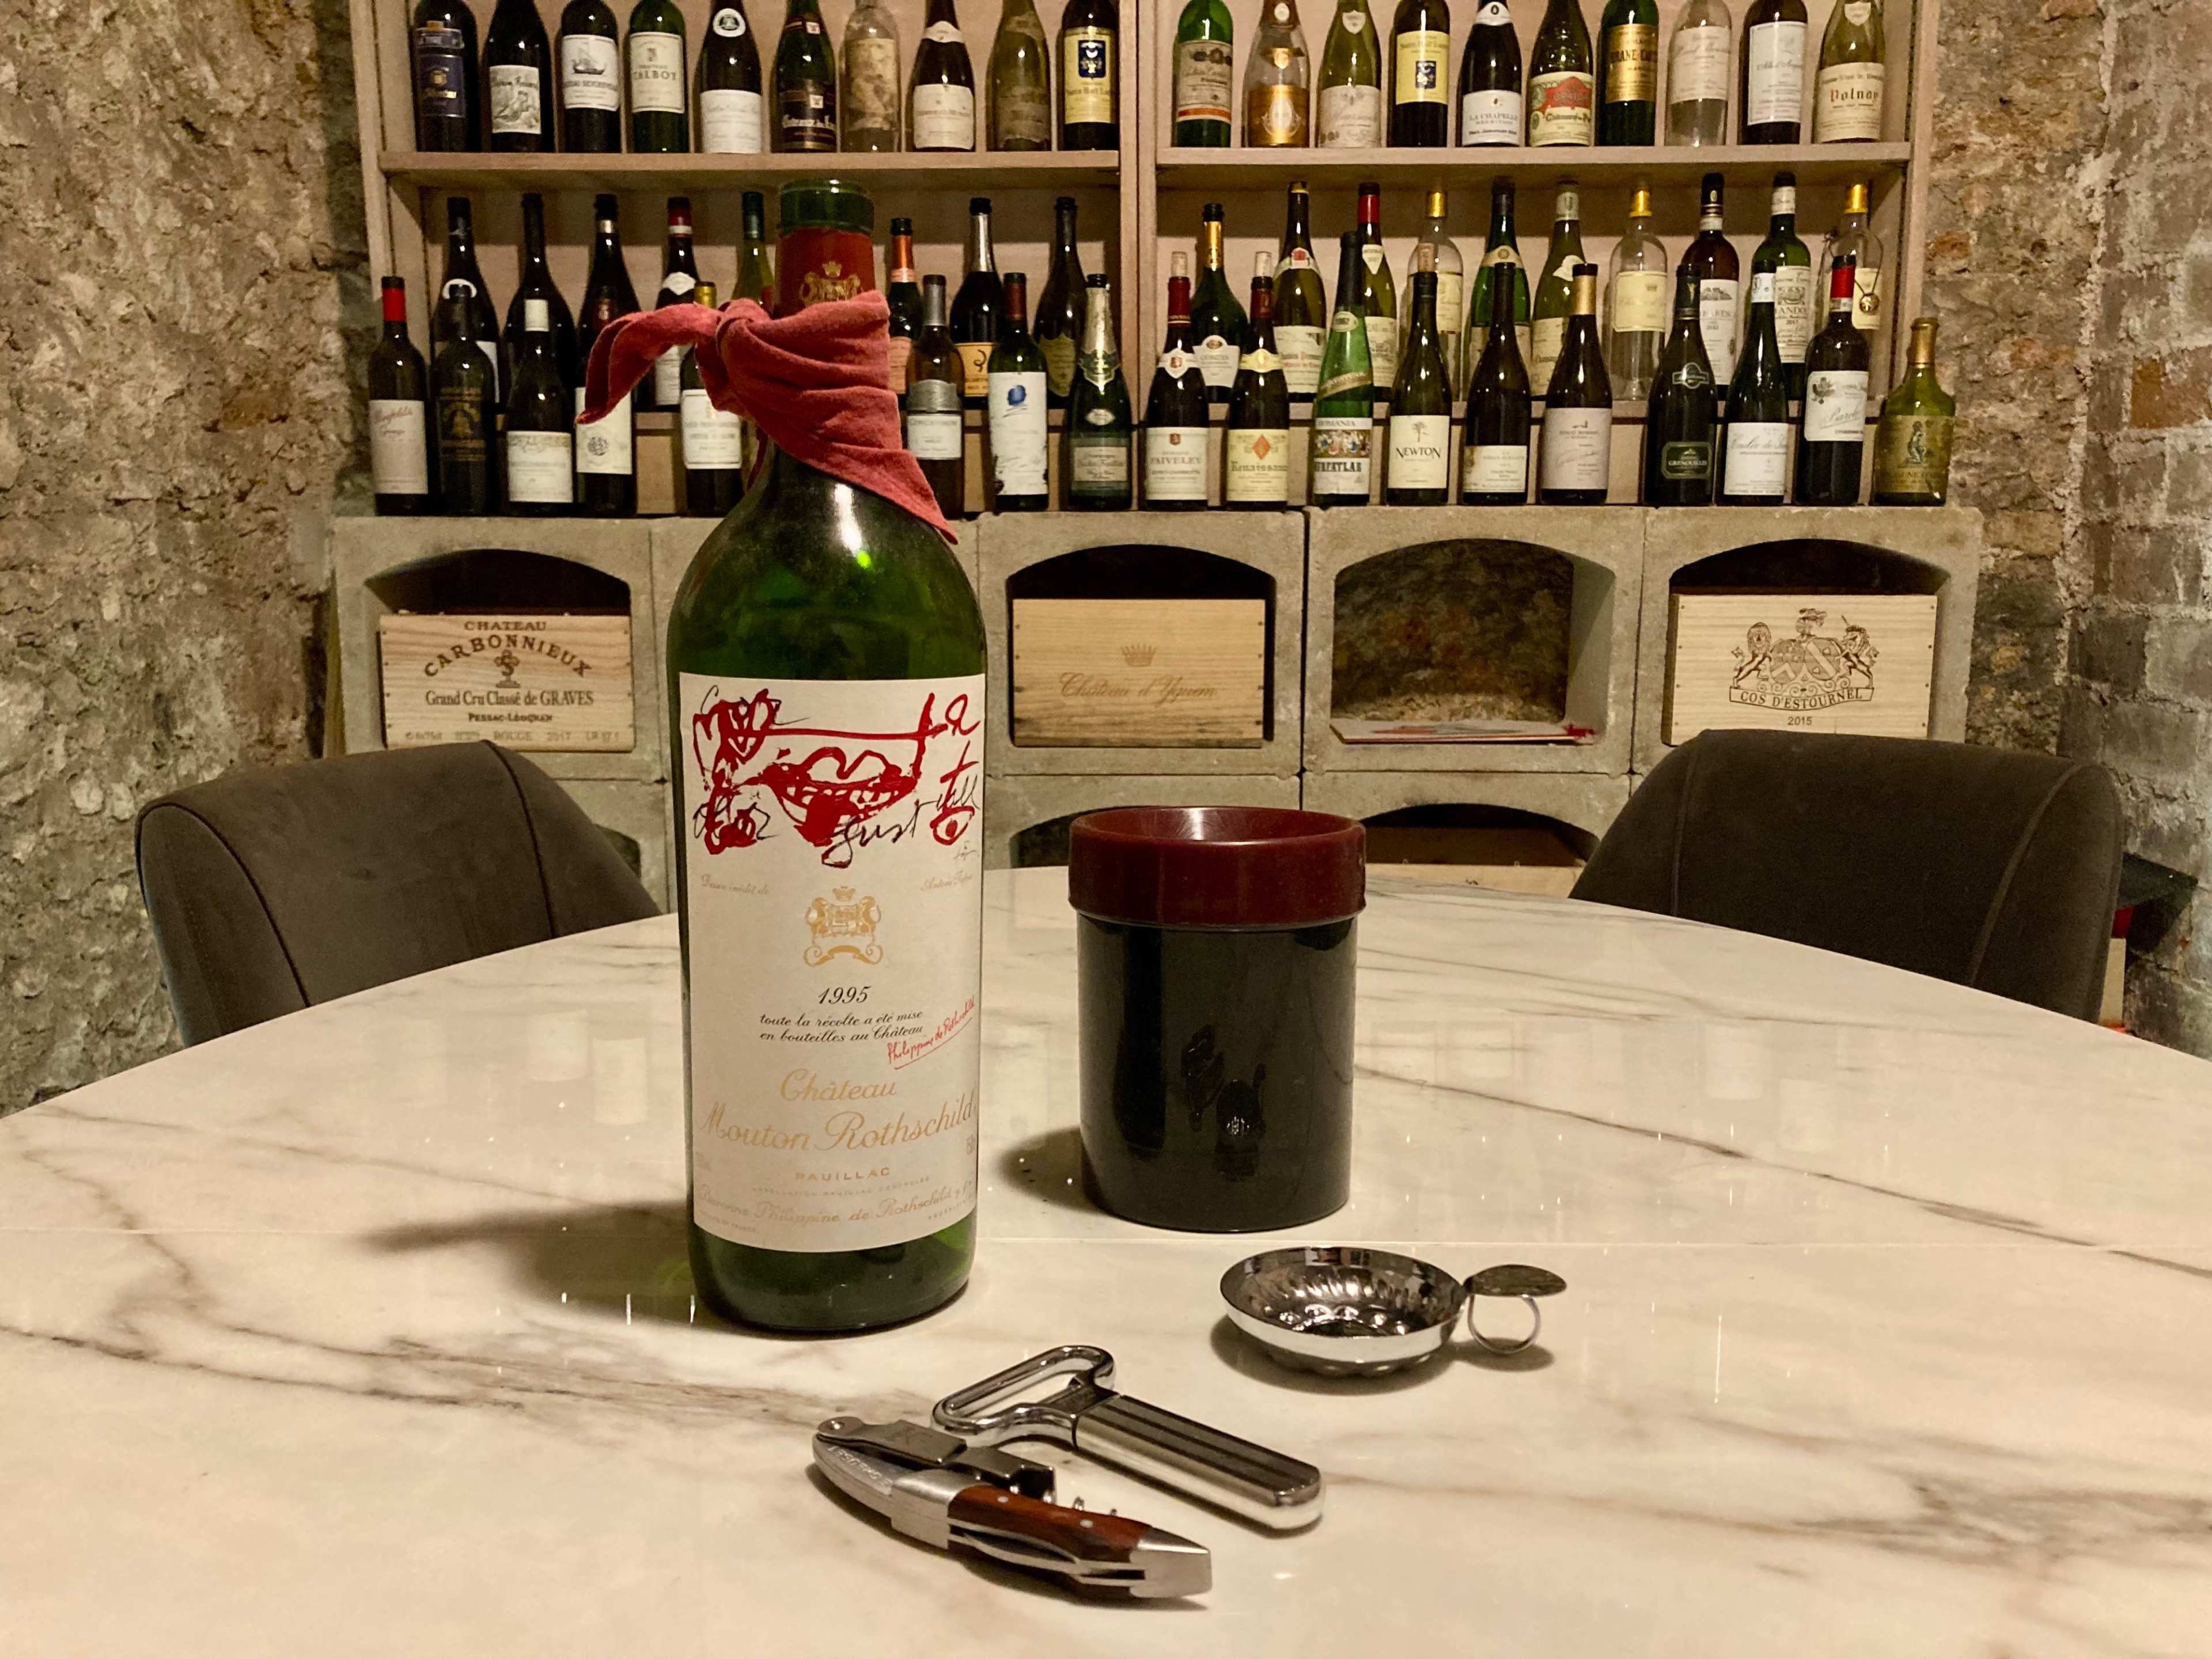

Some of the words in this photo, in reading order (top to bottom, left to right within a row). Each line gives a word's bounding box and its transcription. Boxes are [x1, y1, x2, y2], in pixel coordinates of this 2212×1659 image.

[1396, 446, 1441, 459] NEWTON
[464, 621, 547, 631] CHATEAU
[424, 634, 592, 677] CARBONNIEUX
[425, 690, 460, 706] Grand
[463, 690, 484, 706] Cru
[524, 691, 537, 706] de
[540, 690, 594, 706] GRAVES
[1740, 691, 1767, 704] COS
[1772, 688, 1863, 710] D'ESTOURNEL
[1787, 716, 1813, 726] 2015
[817, 986, 872, 1005] 1995
[760, 1013, 791, 1027] toute
[797, 1012, 810, 1027] la
[816, 1012, 860, 1027] récolte
[876, 1012, 893, 1024] été
[897, 1010, 923, 1022] mise
[760, 1031, 775, 1040] en
[781, 1028, 845, 1043] bouteilles
[850, 1032, 869, 1041] au
[871, 1024, 924, 1040] Château
[779, 1069, 897, 1103] Château
[698, 1101, 812, 1151] Mouton
[813, 1087, 975, 1152] Rothschild
[795, 1167, 891, 1181] PAUILLAC
[847, 1209, 869, 1221] de
